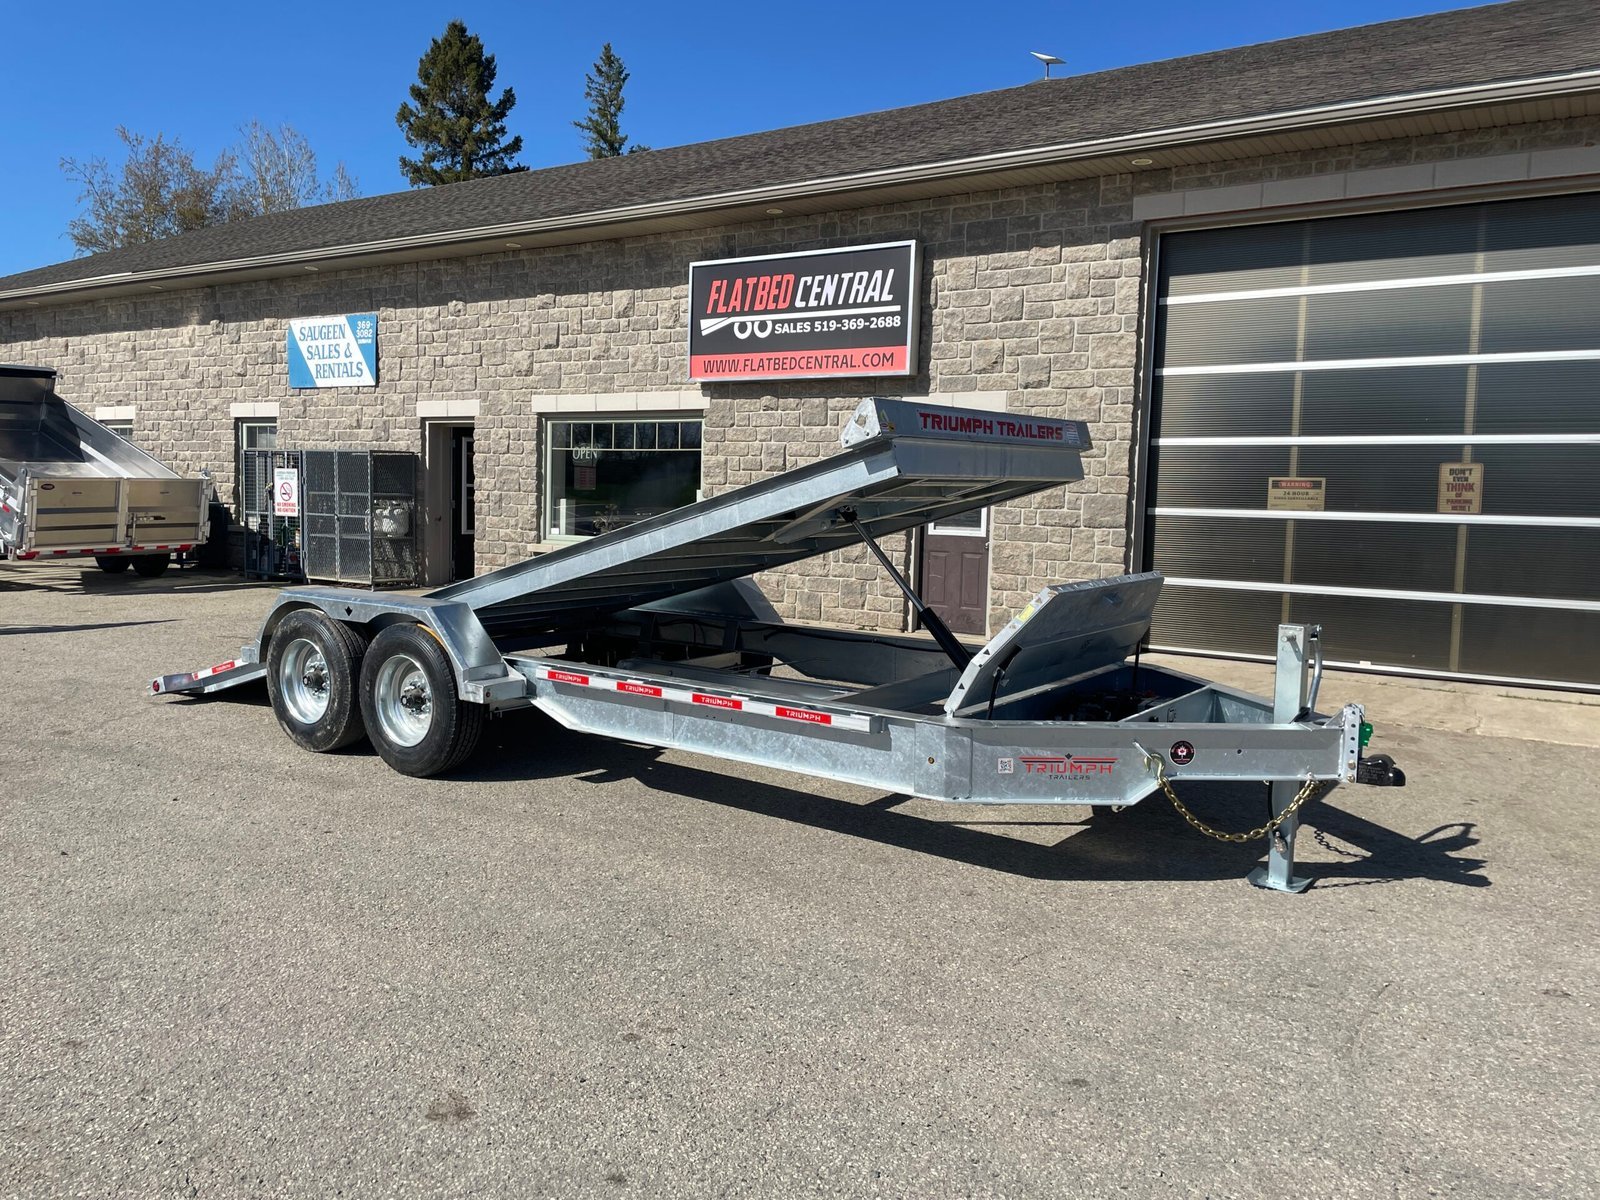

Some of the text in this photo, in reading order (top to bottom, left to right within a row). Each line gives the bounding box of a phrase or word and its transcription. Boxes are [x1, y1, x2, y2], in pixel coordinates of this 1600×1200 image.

[707, 268, 895, 314] FLATBED CENTRAL
[774, 315, 901, 334] SALES 519-369-2688
[299, 323, 346, 342] SAUGEEN
[356, 329, 373, 338] 3082
[306, 342, 353, 361] SALES &
[703, 352, 895, 374] WWW.FLATBEDCENTRAL.COM
[315, 361, 364, 380] RENTALS
[918, 412, 993, 435] TRIUMPH
[996, 420, 1064, 441] TRAILERS
[572, 446, 598, 460] OPEN
[1449, 467, 1473, 476] DON'T
[1446, 482, 1475, 493] THINK
[555, 673, 582, 683] TRIUMPH
[624, 684, 654, 695] TRIUMPH
[701, 696, 733, 708] TRIUMPH
[785, 710, 821, 721] TRIUMPH
[1025, 763, 1113, 774] TRIUMPH
